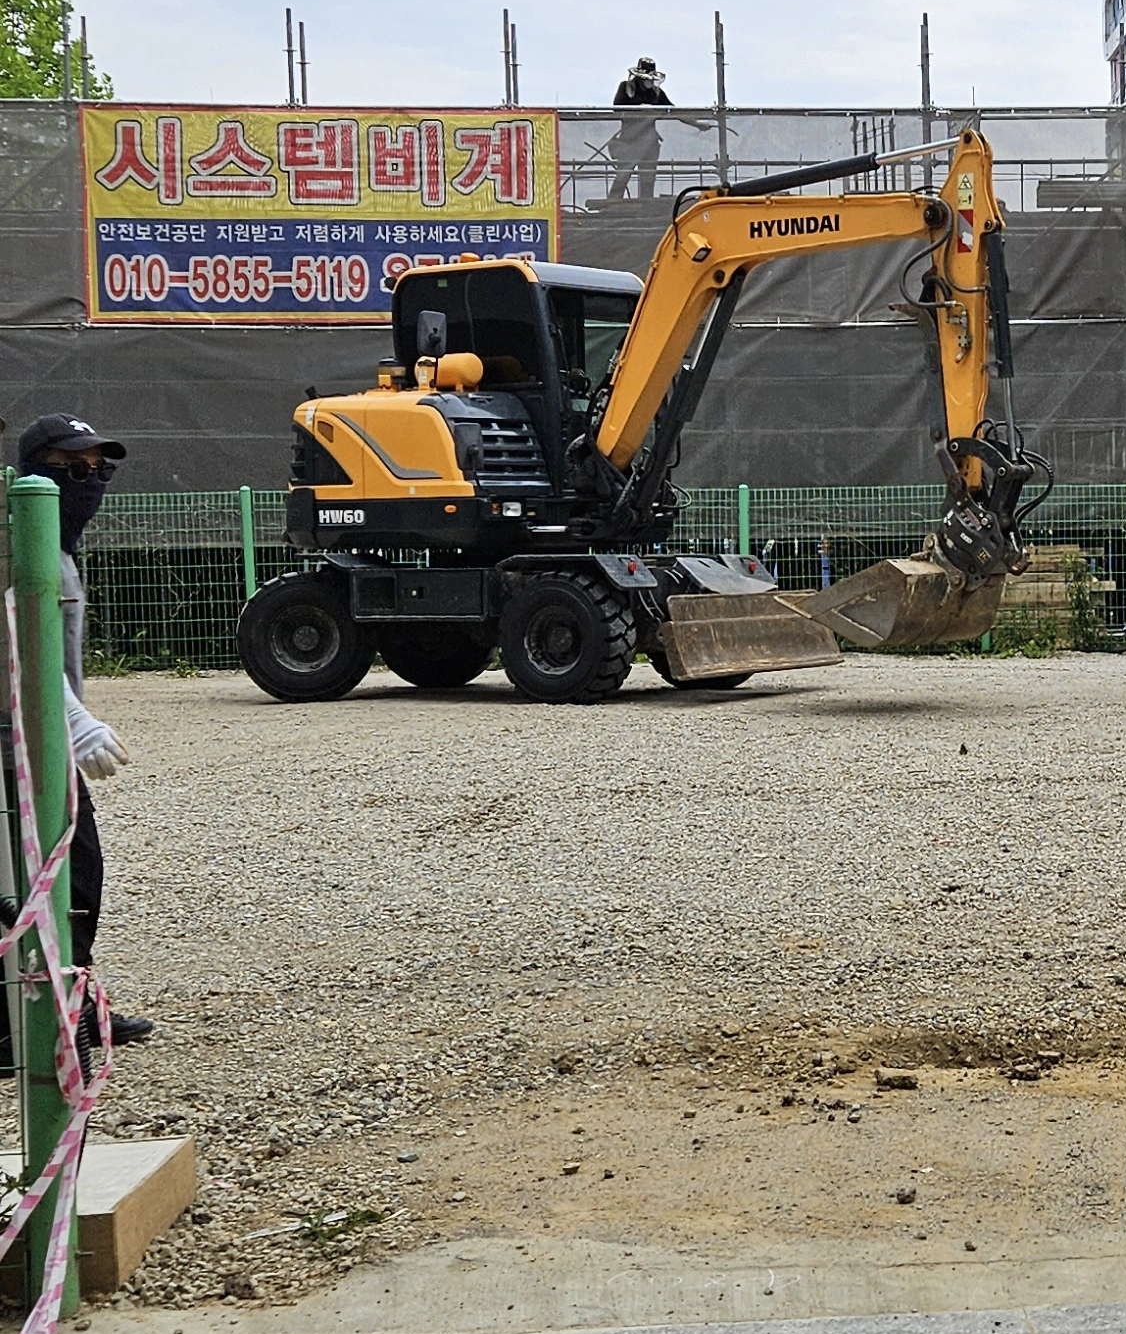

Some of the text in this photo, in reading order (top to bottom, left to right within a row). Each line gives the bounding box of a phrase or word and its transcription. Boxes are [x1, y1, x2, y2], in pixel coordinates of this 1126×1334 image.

[96, 116, 534, 206] 시스템비계
[99, 223, 542, 244] 안전보건공단 지원받고 저렴하게 사용하세요(클린사업)
[749, 214, 840, 239] HYUNDAI
[105, 254, 369, 302] 010-5855-5119
[318, 509, 365, 525] HW60
